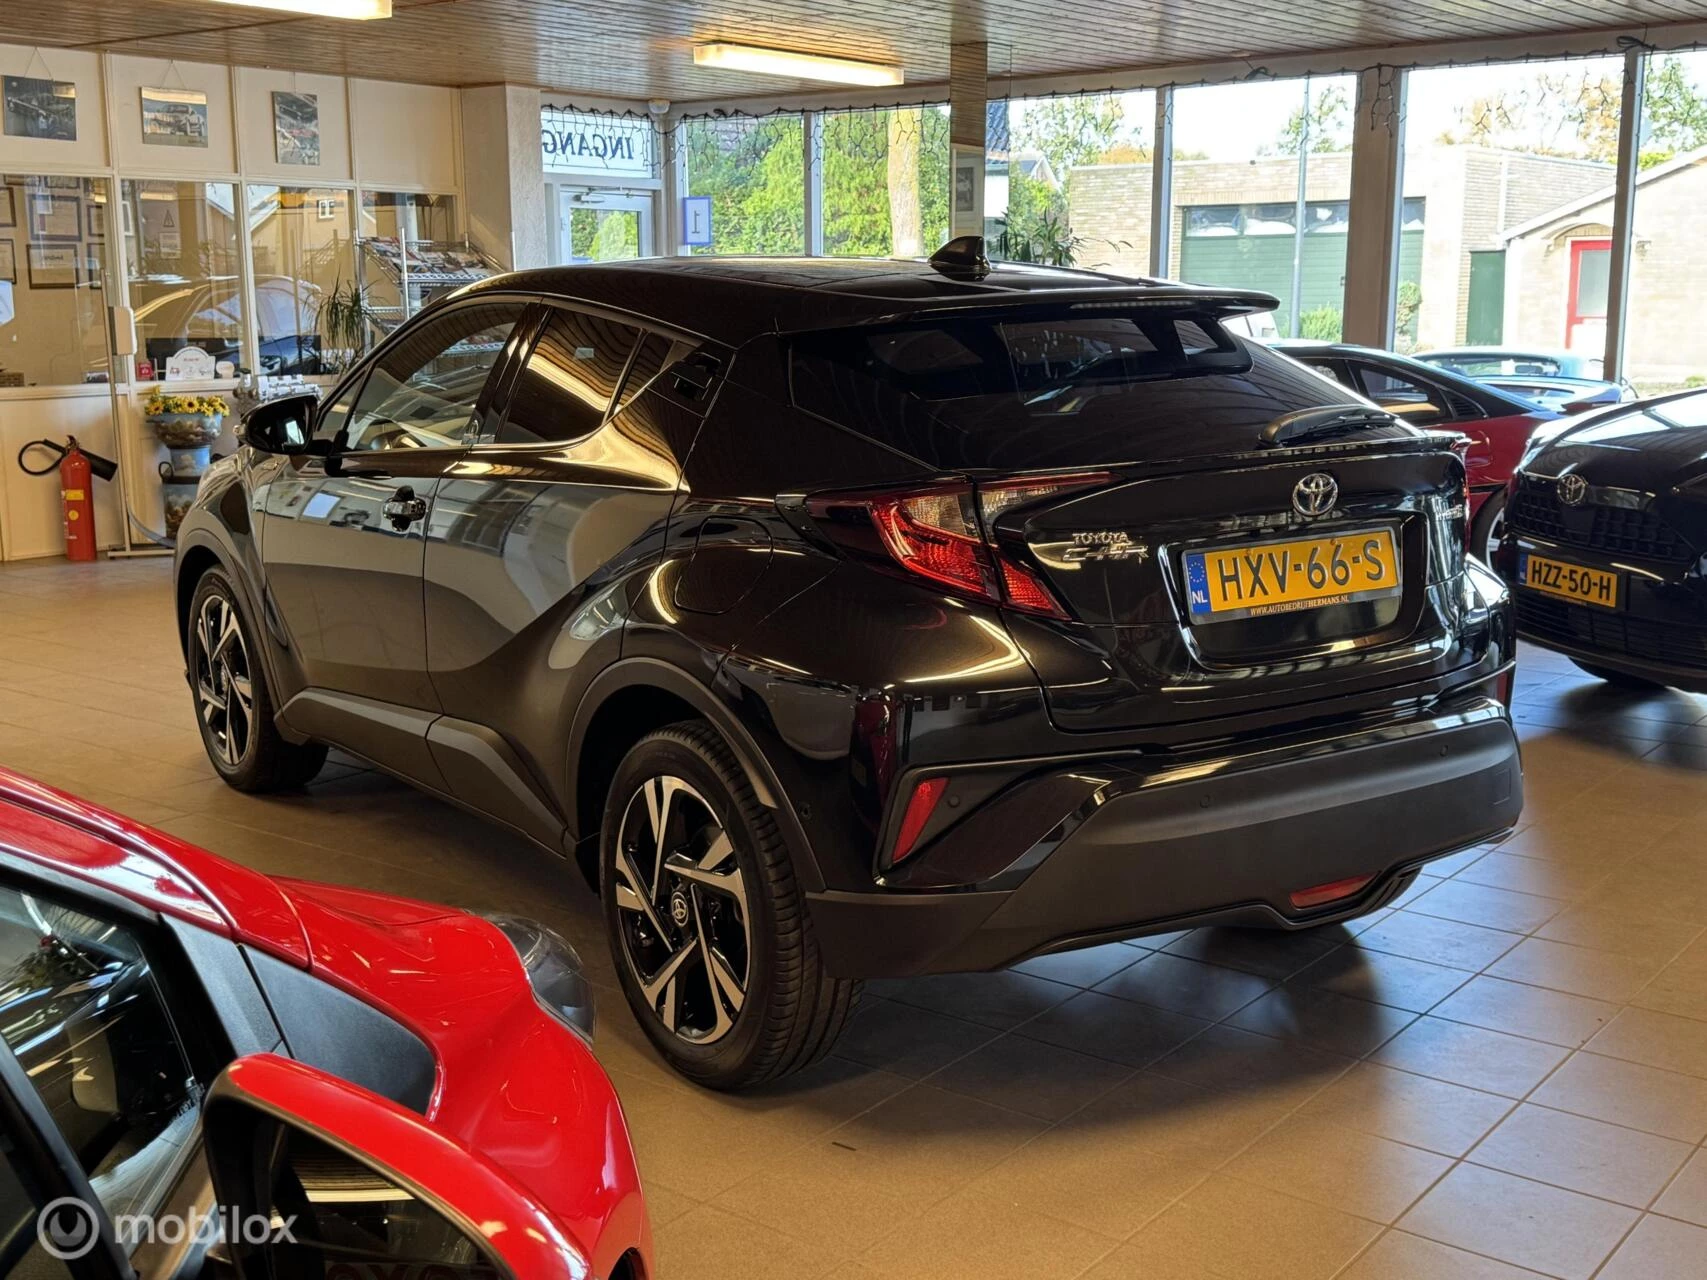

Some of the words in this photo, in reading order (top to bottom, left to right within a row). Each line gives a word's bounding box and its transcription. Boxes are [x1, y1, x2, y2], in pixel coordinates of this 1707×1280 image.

[1072, 531, 1130, 545] TOYOTA
[1217, 539, 1385, 602] HXV-66-S
[1531, 560, 1611, 601] HZZ-50-H
[1191, 590, 1208, 604] NL
[1250, 595, 1350, 616] WWW.AUTOBEDRIJFHERMANS.NL
